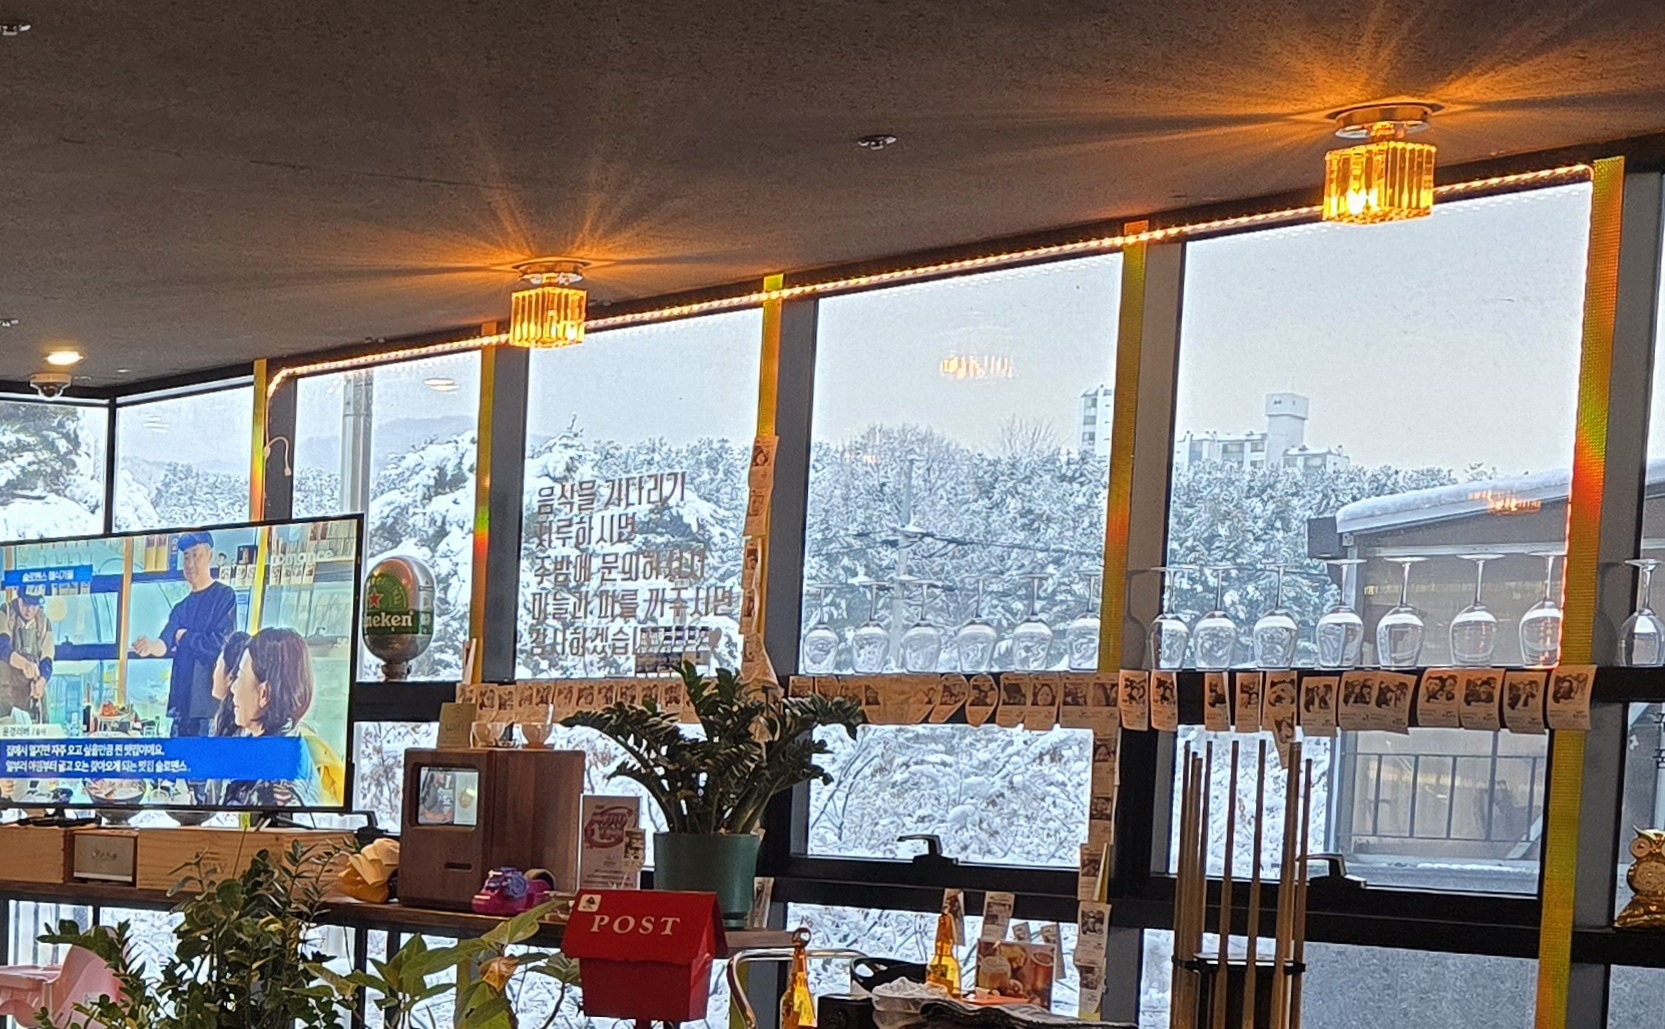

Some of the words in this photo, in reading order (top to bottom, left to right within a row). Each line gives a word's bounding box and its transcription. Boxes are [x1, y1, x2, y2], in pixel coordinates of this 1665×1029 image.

[537, 479, 596, 515] 음식을
[603, 471, 687, 509] 기다리기
[535, 512, 637, 548] 지루하시면
[67, 744, 83, 756] 오고
[138, 760, 154, 773] 맛집
[590, 914, 681, 936] POST
